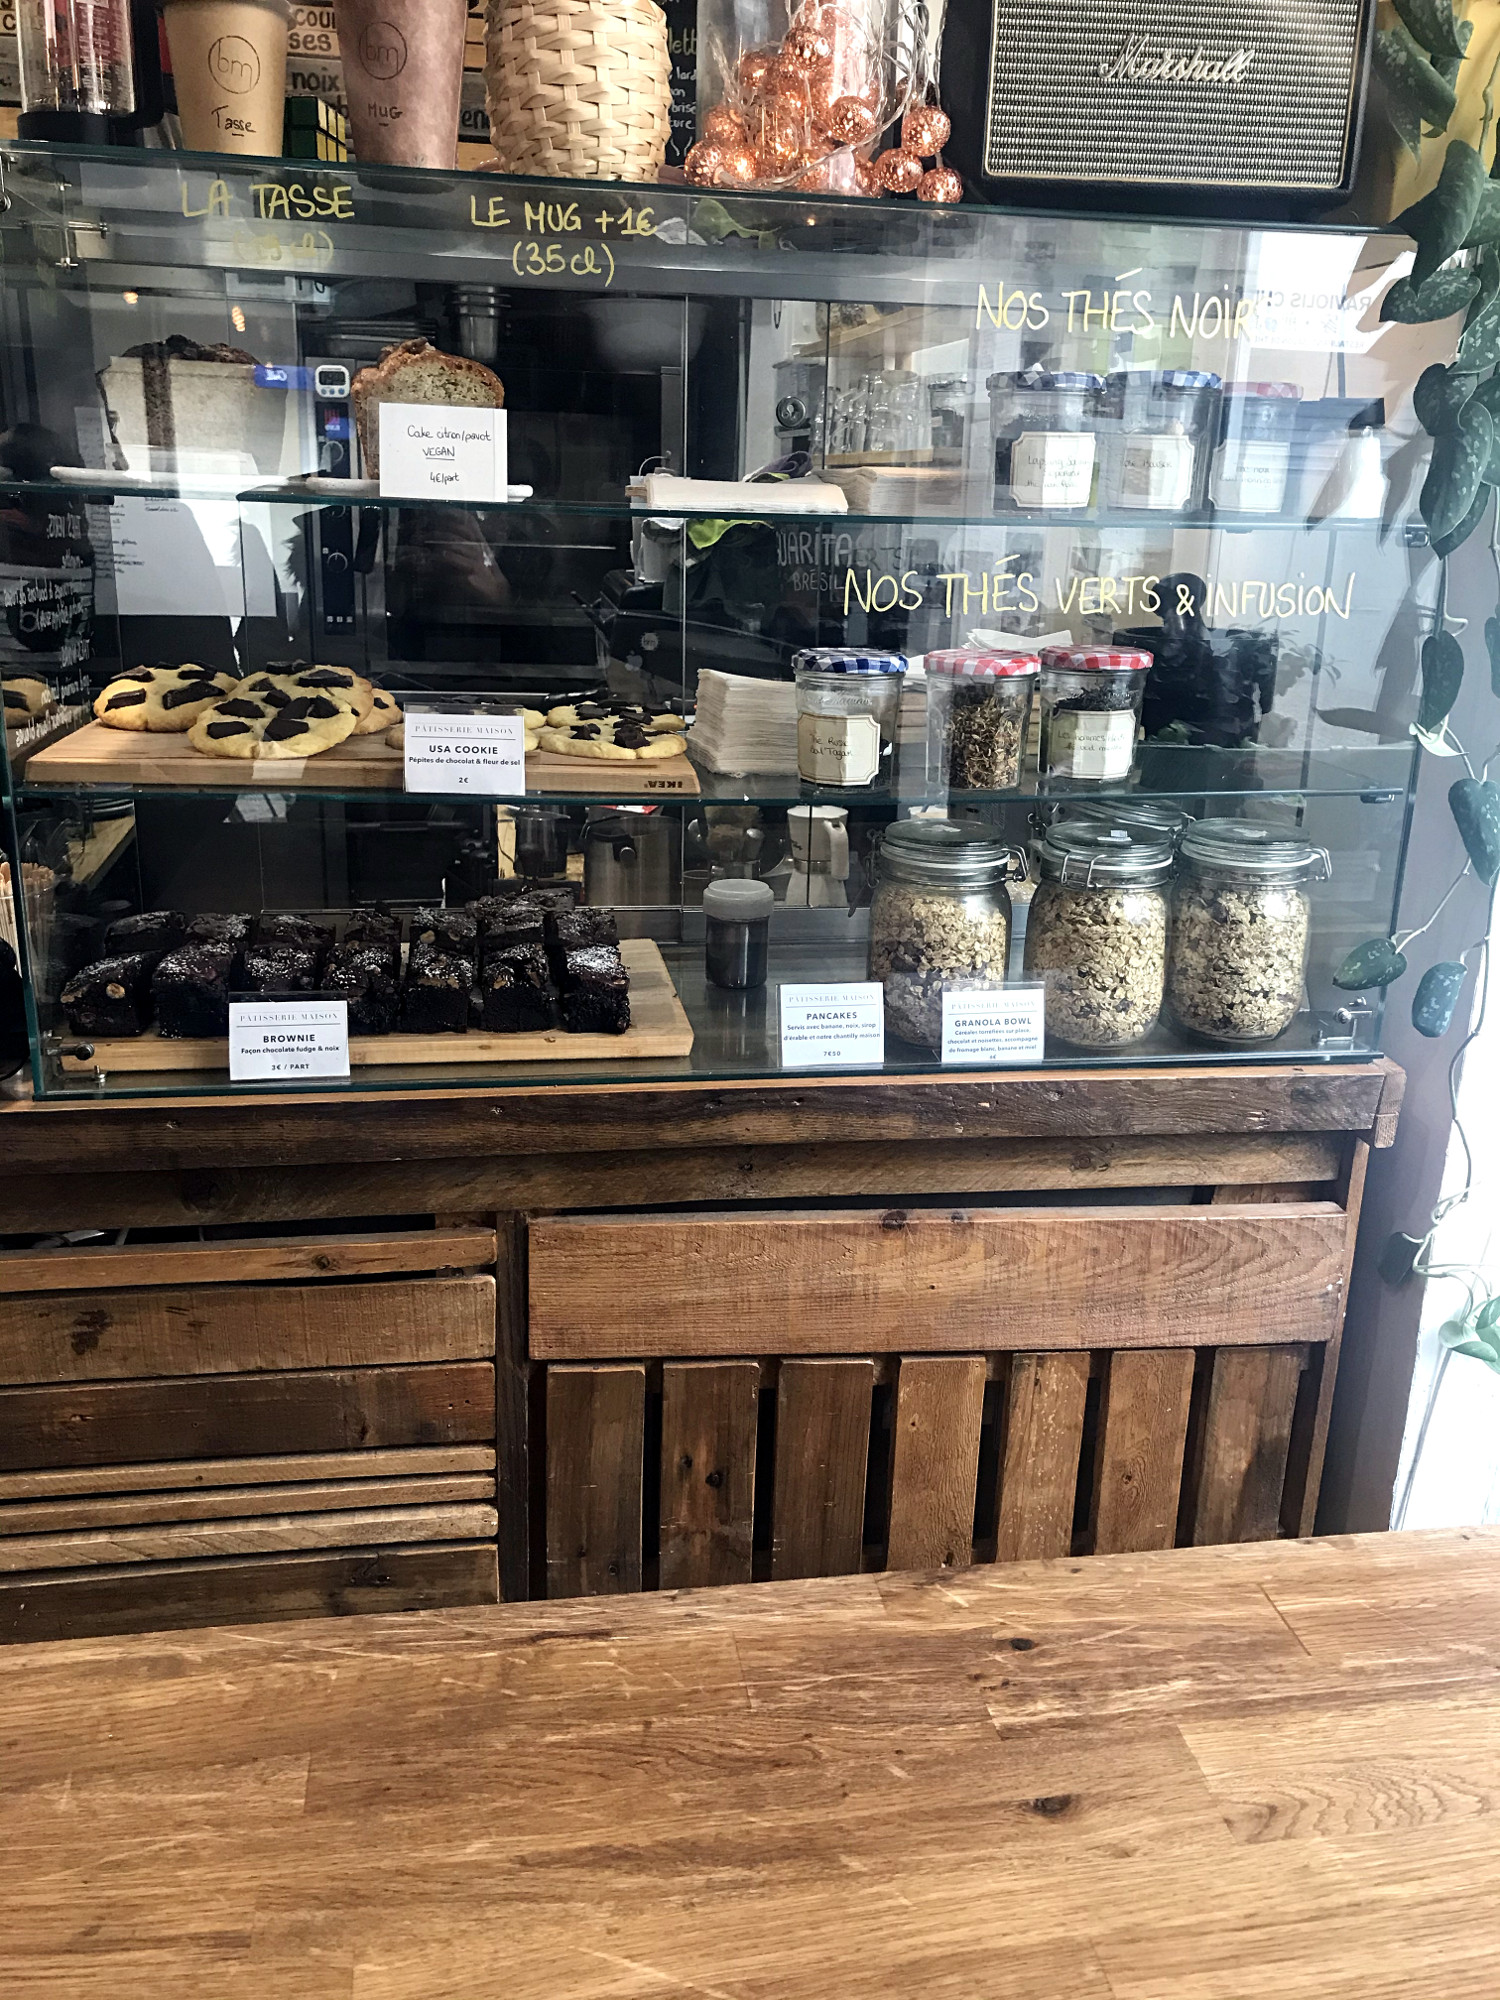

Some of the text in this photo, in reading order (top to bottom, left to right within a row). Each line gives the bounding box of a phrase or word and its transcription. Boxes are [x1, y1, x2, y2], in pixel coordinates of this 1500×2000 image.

[1100, 32, 1256, 83] Marshall
[291, 66, 341, 92] noix
[211, 104, 257, 134] Tasse
[181, 179, 355, 220] LA TASSE
[470, 194, 511, 228] LE
[524, 201, 583, 234] MUG
[974, 281, 1050, 332] NOS
[1061, 267, 1156, 338] THÉS
[407, 424, 434, 439] Cake
[422, 446, 455, 458] VEGAN
[792, 568, 845, 592] BRÉSIL
[842, 568, 924, 616] NOS
[935, 554, 1040, 620] THÉS
[1054, 573, 1161, 616] VERTS
[1175, 584, 1195, 616] &
[1205, 571, 1357, 620] INFUSION
[476, 727, 514, 735] MAISON
[429, 744, 499, 755] USA COOKIE
[409, 756, 434, 766] Pépites
[445, 757, 475, 765] chocolat
[483, 758, 499, 766] fleur
[500, 758, 510, 766] de
[647, 780, 683, 789] IKEA
[806, 1011, 858, 1021] PANCAKES
[954, 1017, 1032, 1028] GRANOLA BOWL
[263, 1034, 315, 1043] BROWNIE
[241, 1047, 261, 1055] Façon
[262, 1046, 295, 1054] chocolate
[296, 1045, 316, 1054] fudge
